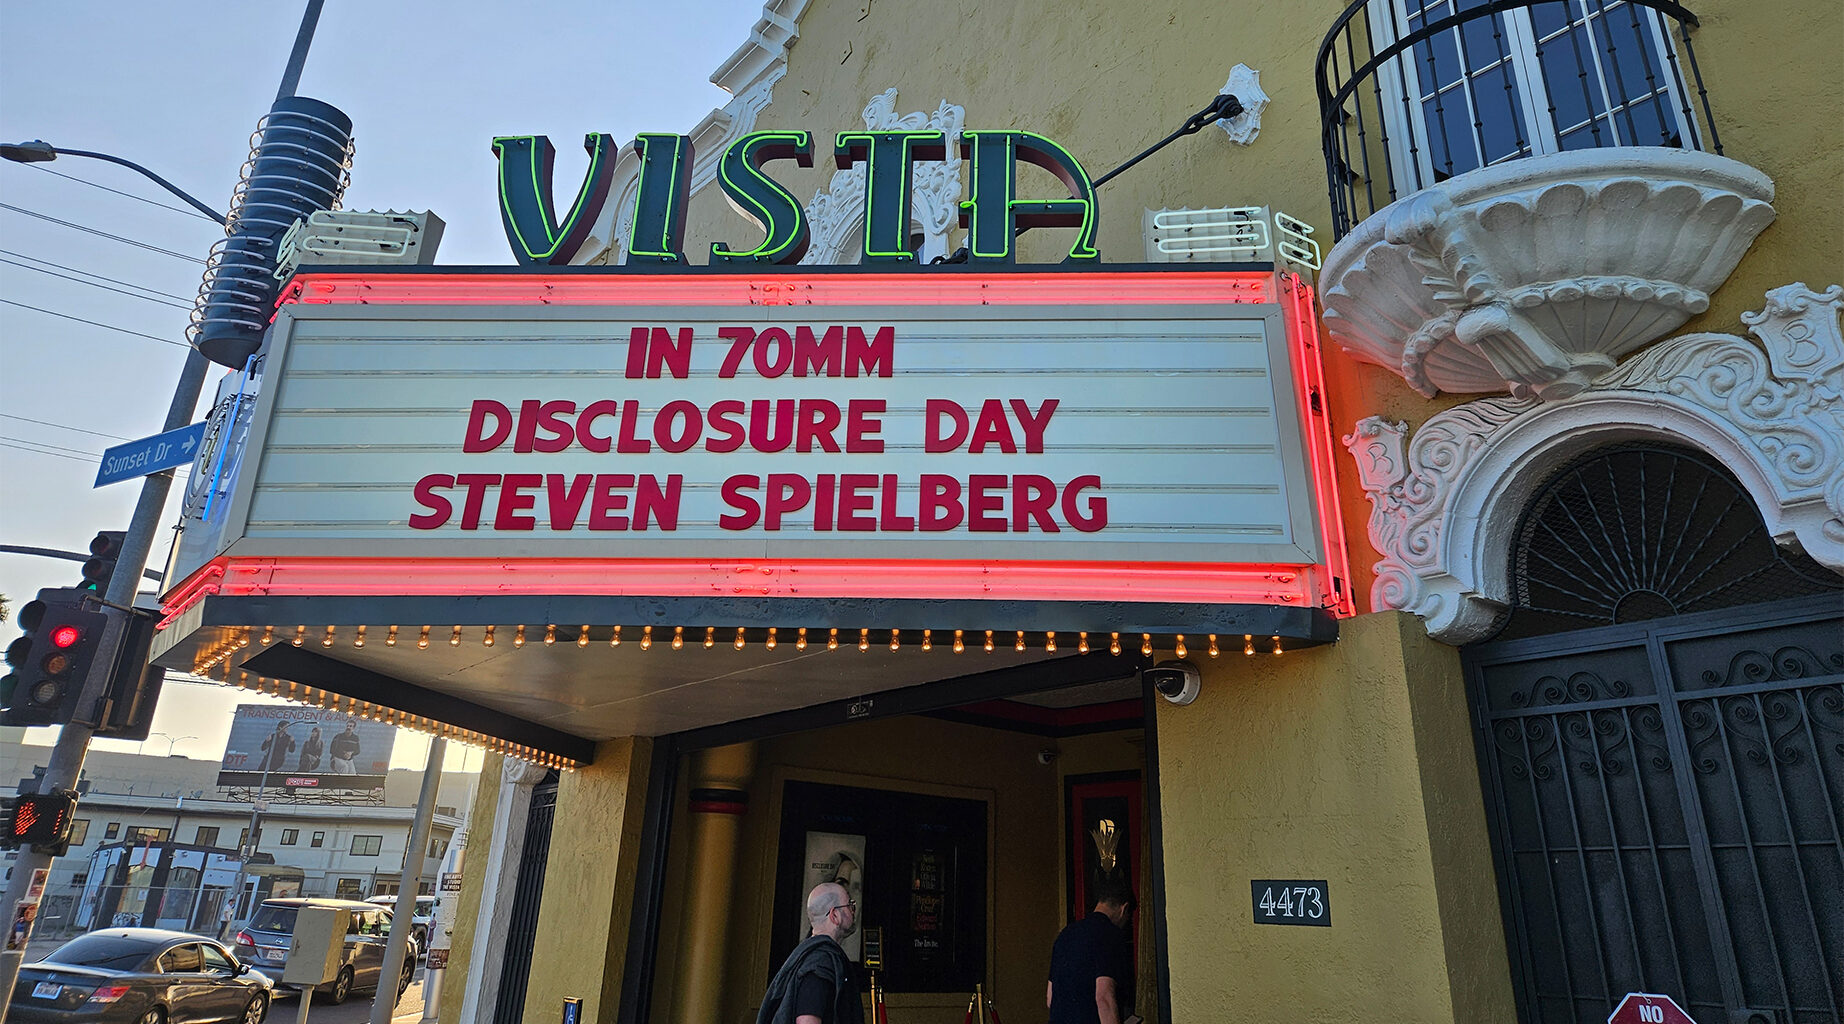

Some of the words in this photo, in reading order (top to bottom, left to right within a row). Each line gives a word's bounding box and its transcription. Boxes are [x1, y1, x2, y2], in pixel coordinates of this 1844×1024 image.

[491, 129, 1100, 264] VISTA
[625, 327, 694, 379] IN
[718, 326, 895, 379] 70MM
[463, 400, 886, 454] DISCLOSURE
[925, 399, 1060, 454] DAY
[104, 446, 152, 476] Sunset
[154, 442, 172, 463] Dr
[408, 473, 683, 531] STEVEN
[719, 473, 1108, 533] SPIELBERG
[242, 709, 323, 722] TRANSCENDENT
[326, 711, 335, 722] &
[225, 754, 248, 767] DTF
[1259, 887, 1324, 919] 4473
[1639, 1004, 1664, 1024] NO
